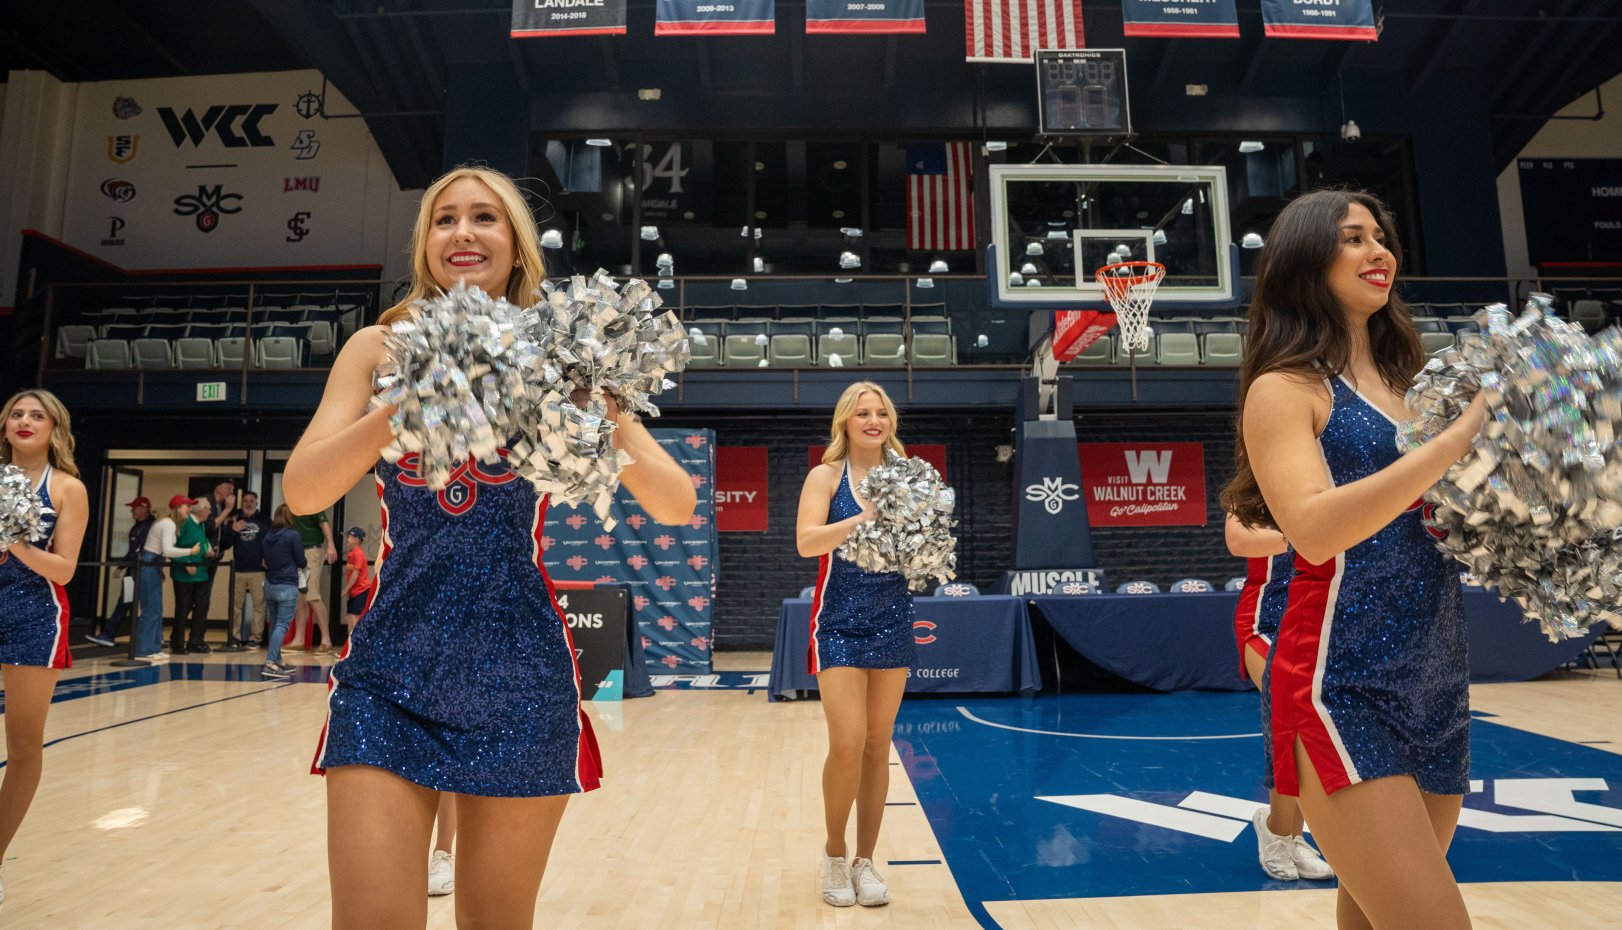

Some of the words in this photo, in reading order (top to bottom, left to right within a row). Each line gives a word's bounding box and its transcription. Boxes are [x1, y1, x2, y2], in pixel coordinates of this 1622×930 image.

[156, 104, 280, 149] WCC
[202, 384, 221, 399] EXIT
[1124, 450, 1172, 484] W
[1108, 476, 1128, 484] VISIT
[450, 485, 462, 503] G
[716, 490, 758, 503] SITY
[1093, 486, 1144, 501] WALNUT
[1147, 486, 1186, 501] CREEK
[565, 613, 604, 629] ONS
[916, 668, 960, 679] COLLEGE
